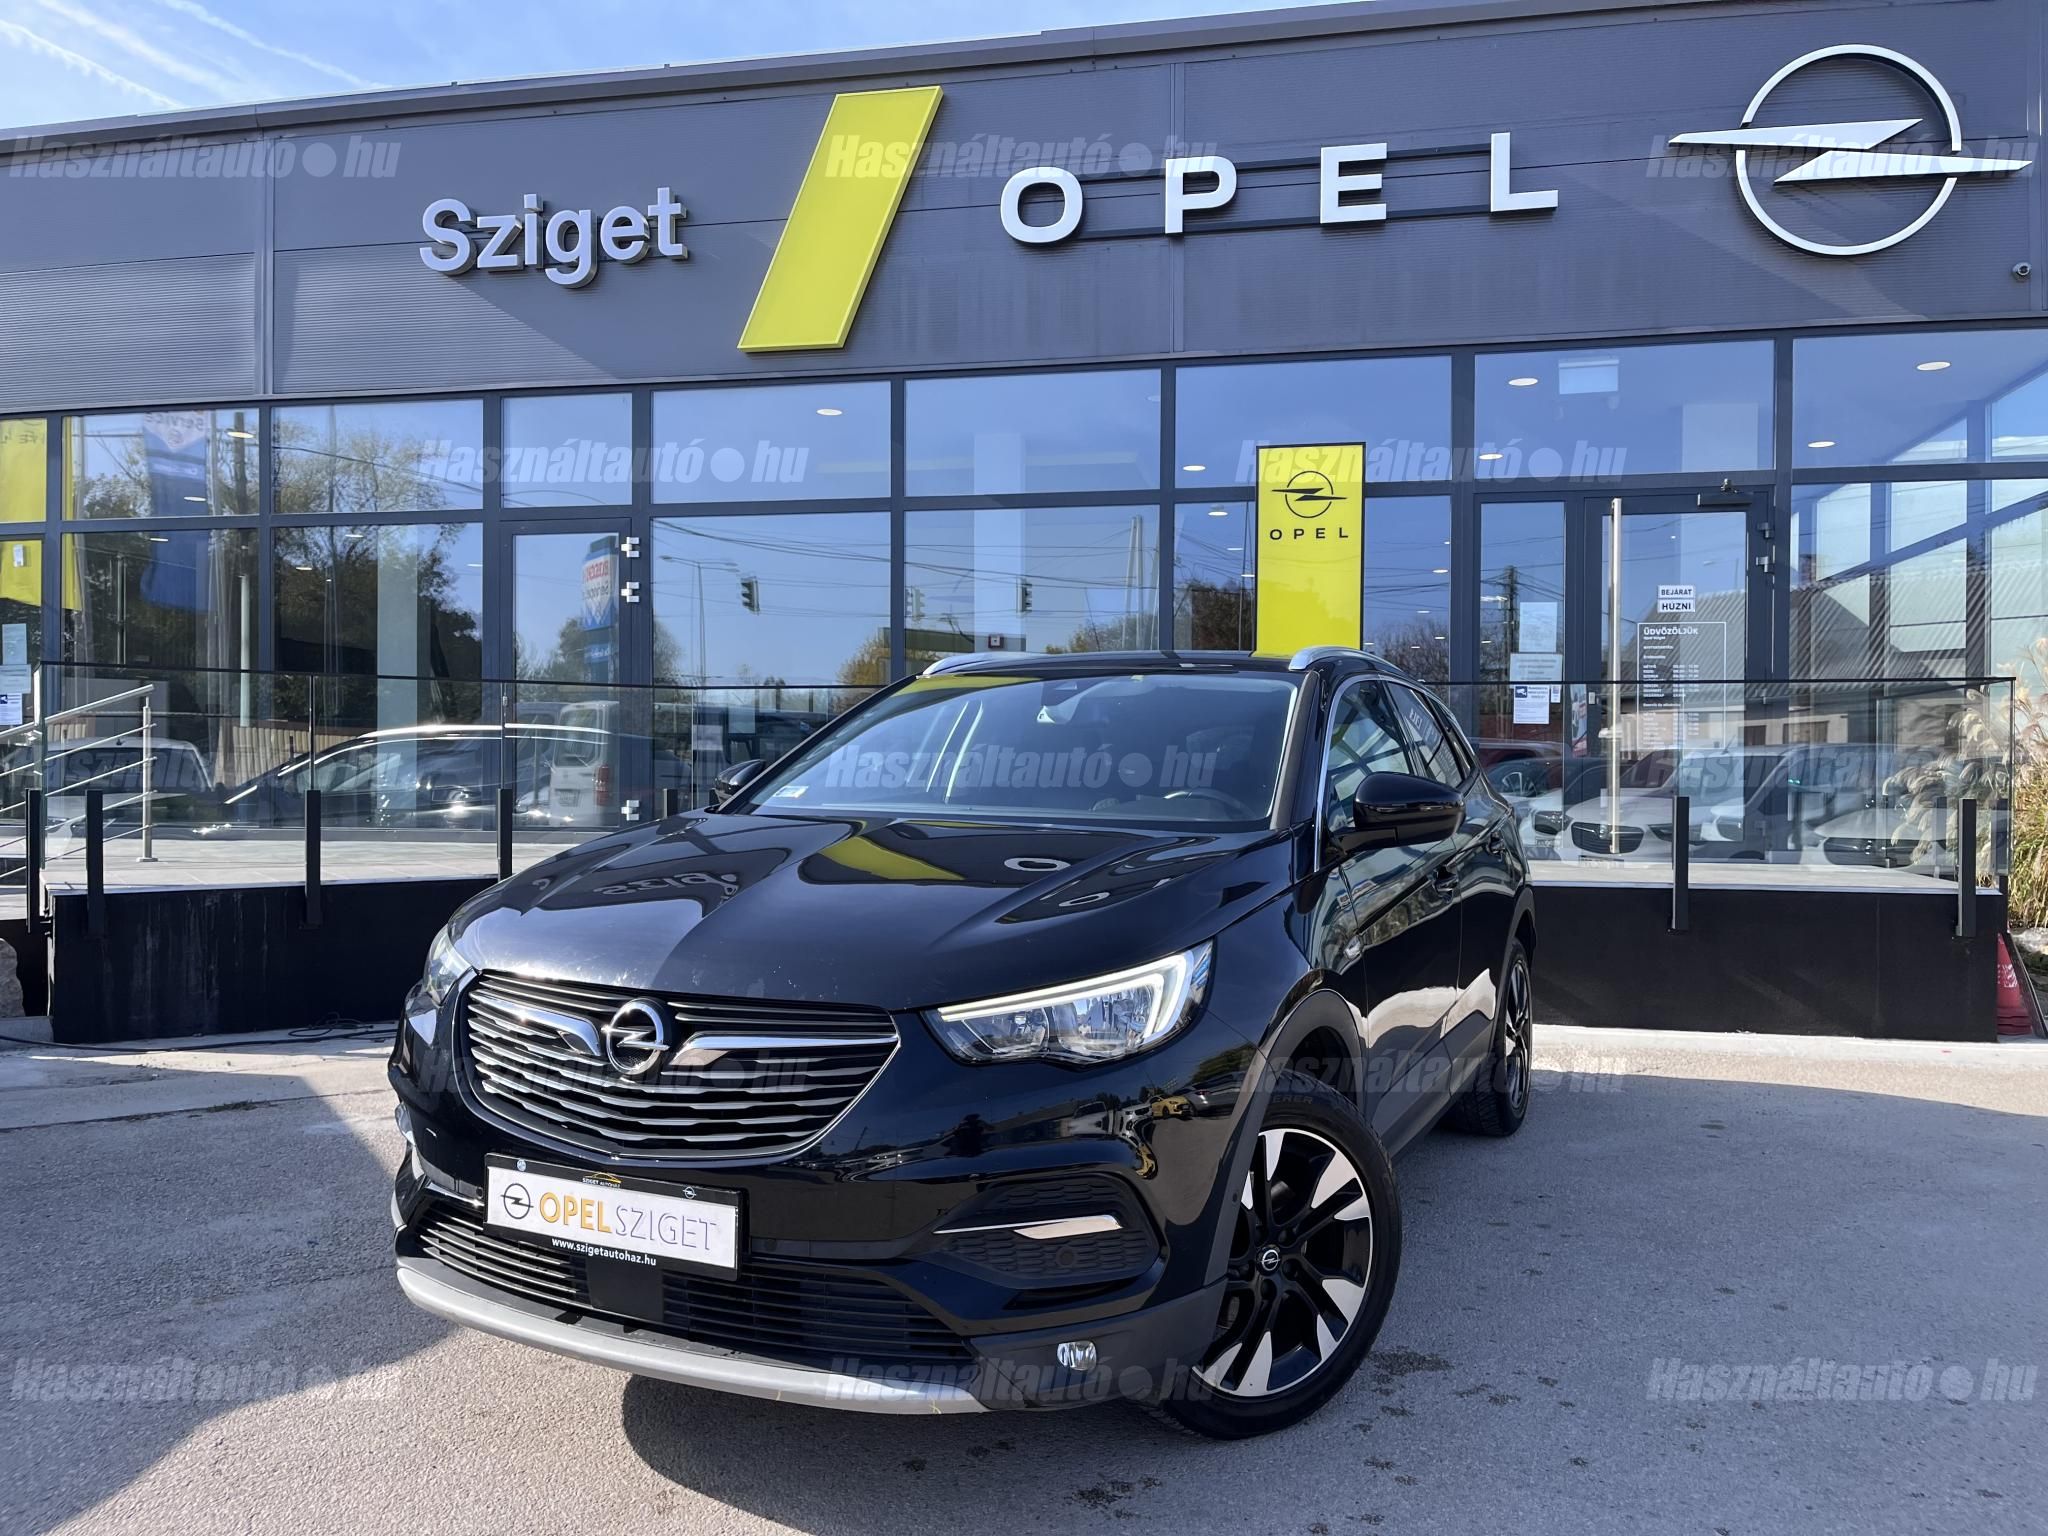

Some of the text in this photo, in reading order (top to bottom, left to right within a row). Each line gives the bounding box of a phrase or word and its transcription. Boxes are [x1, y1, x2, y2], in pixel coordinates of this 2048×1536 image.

[1000, 132, 1559, 244] OPEL
[419, 186, 687, 288] Sziget
[1269, 527, 1349, 541] OPEL
[1661, 588, 1692, 596] BEJÁRAT
[1662, 601, 1691, 610] HÚZNI
[551, 1238, 657, 1266] www.szigetautohaz.hu
